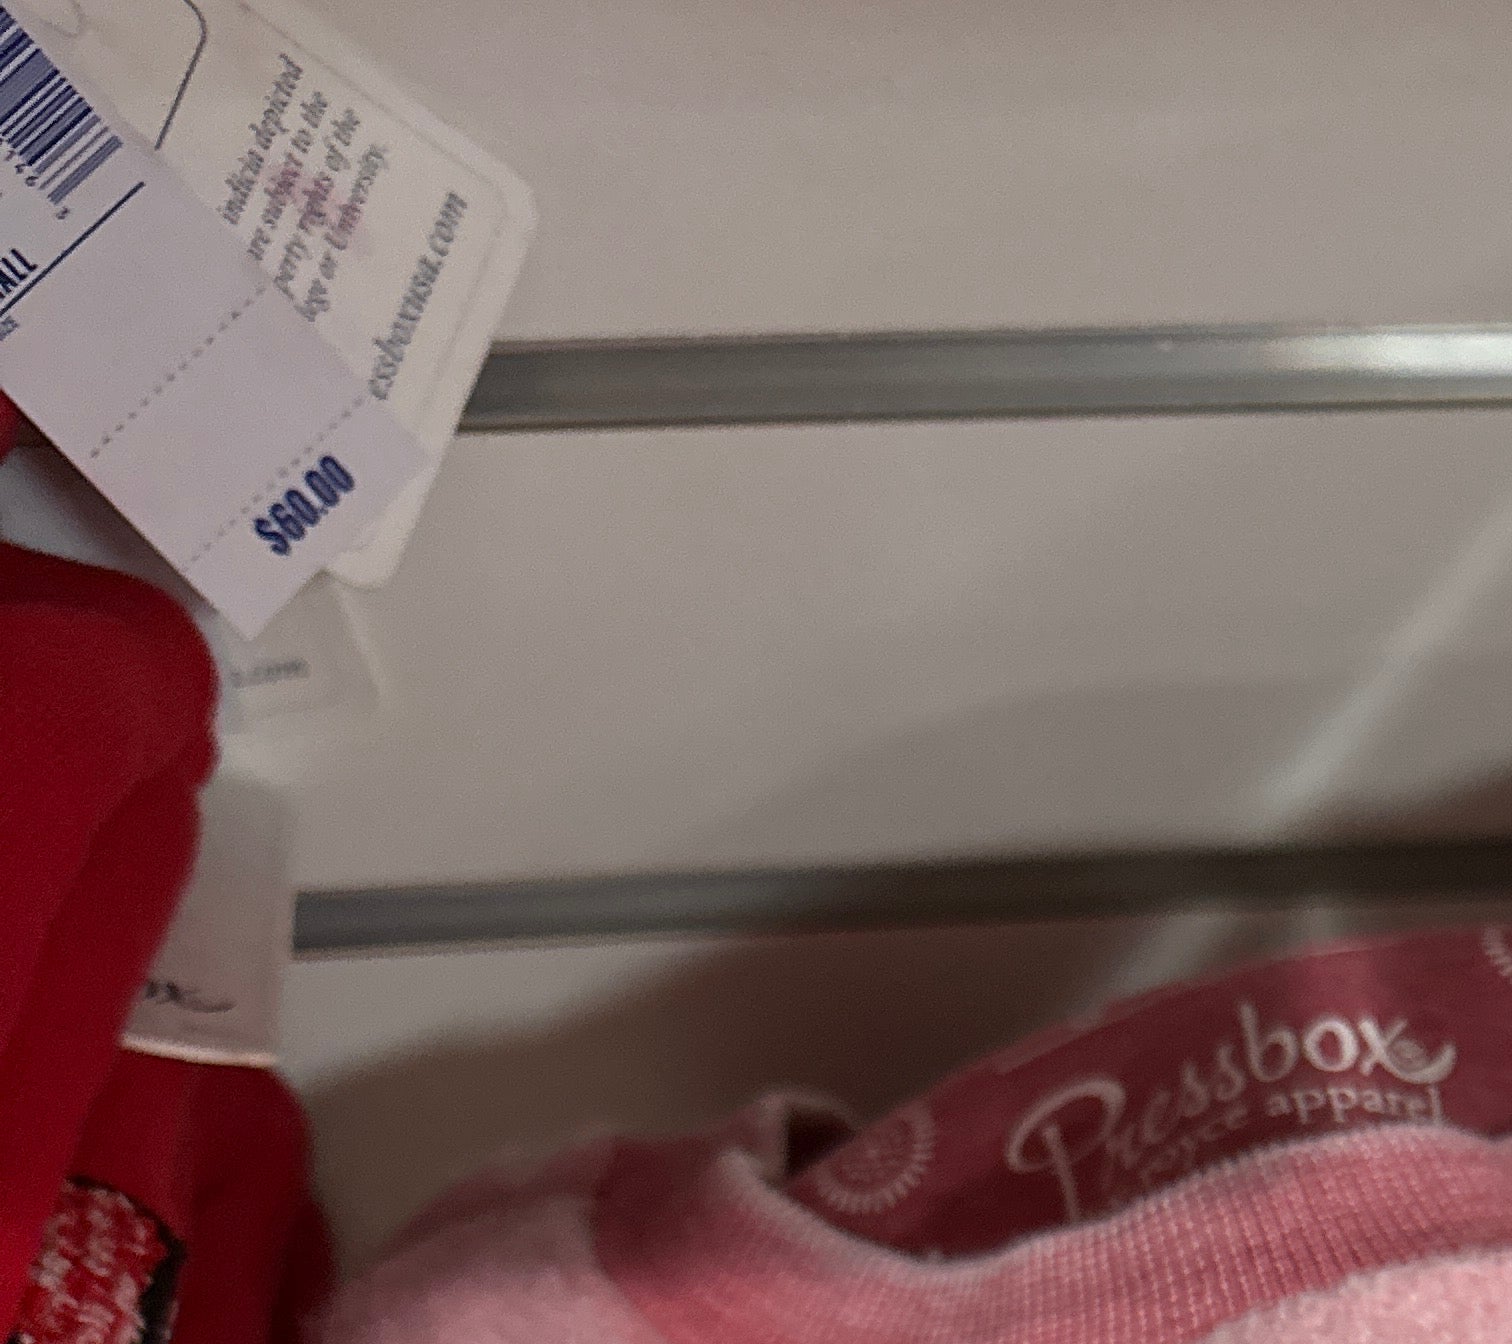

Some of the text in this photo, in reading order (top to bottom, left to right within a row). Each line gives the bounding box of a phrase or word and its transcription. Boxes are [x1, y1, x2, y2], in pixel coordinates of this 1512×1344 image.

[301, 91, 328, 129] the
[331, 107, 361, 147] the
[217, 53, 304, 226] indicia depicted
[291, 128, 313, 154] to
[321, 135, 351, 173] of
[262, 152, 303, 230] subject
[297, 172, 335, 236] rights
[0, 248, 38, 301] ALL
[319, 249, 338, 281] or
[254, 455, 356, 557] $60.00
[1003, 1001, 1457, 1223] Pressbox
[1265, 1082, 1445, 1129] apparel
